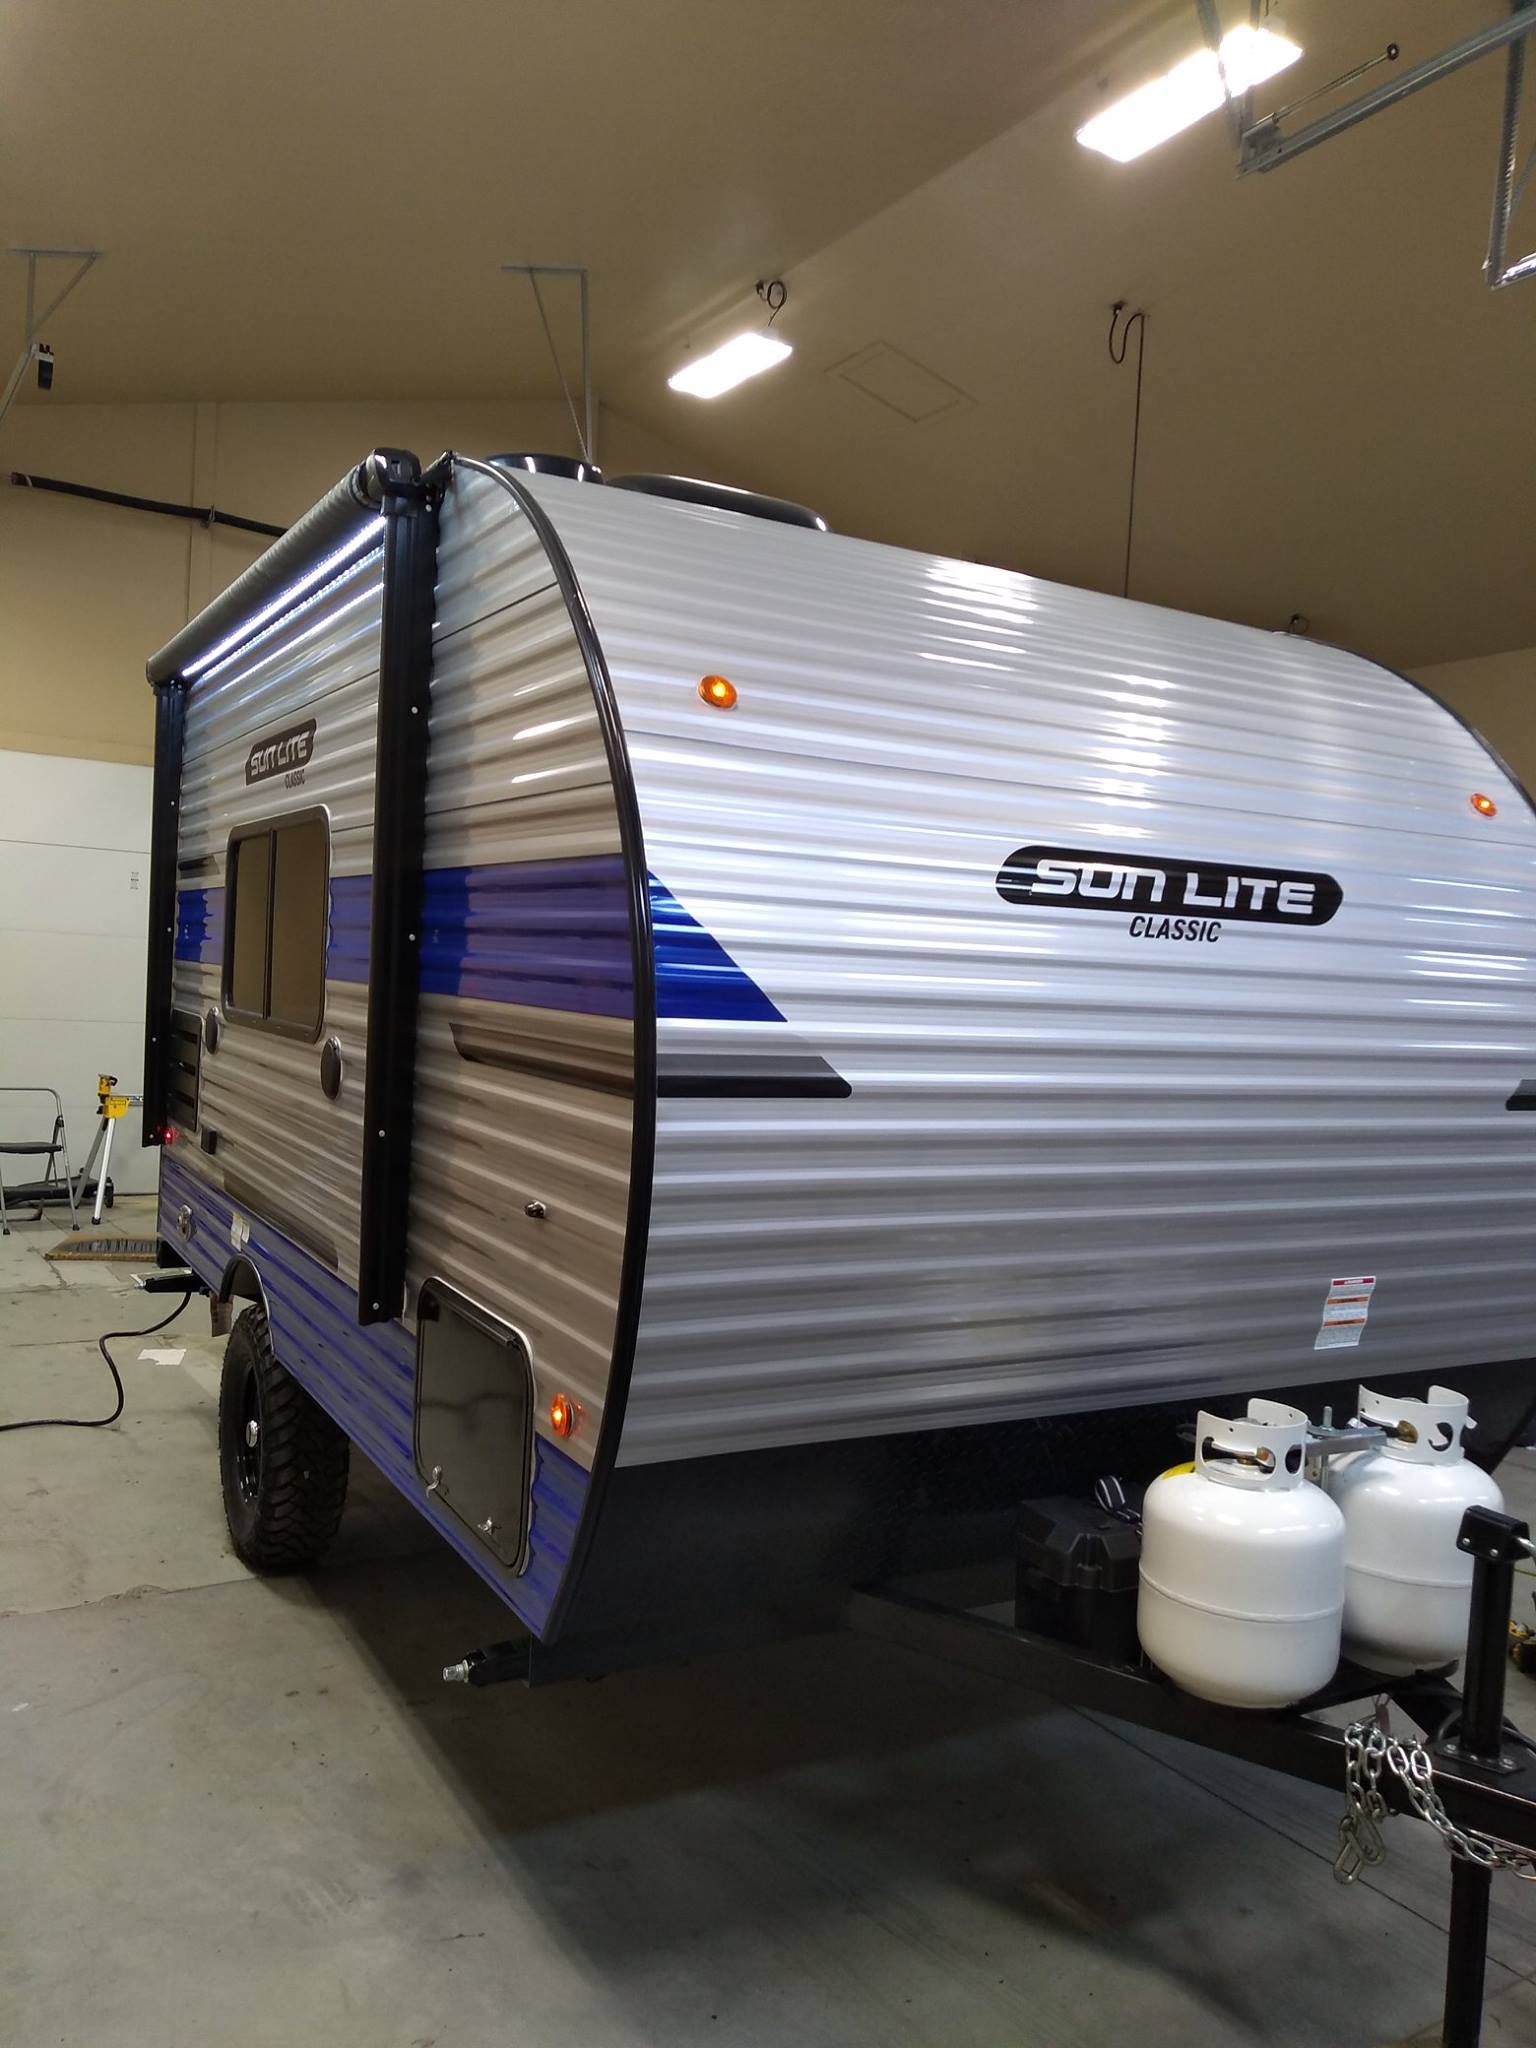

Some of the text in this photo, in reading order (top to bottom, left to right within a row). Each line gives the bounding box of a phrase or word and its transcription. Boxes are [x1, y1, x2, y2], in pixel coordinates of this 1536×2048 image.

[250, 731, 310, 777] SUN LITE
[1030, 858, 1317, 915] SUN LITE
[1128, 915, 1222, 943] CLASSIC
